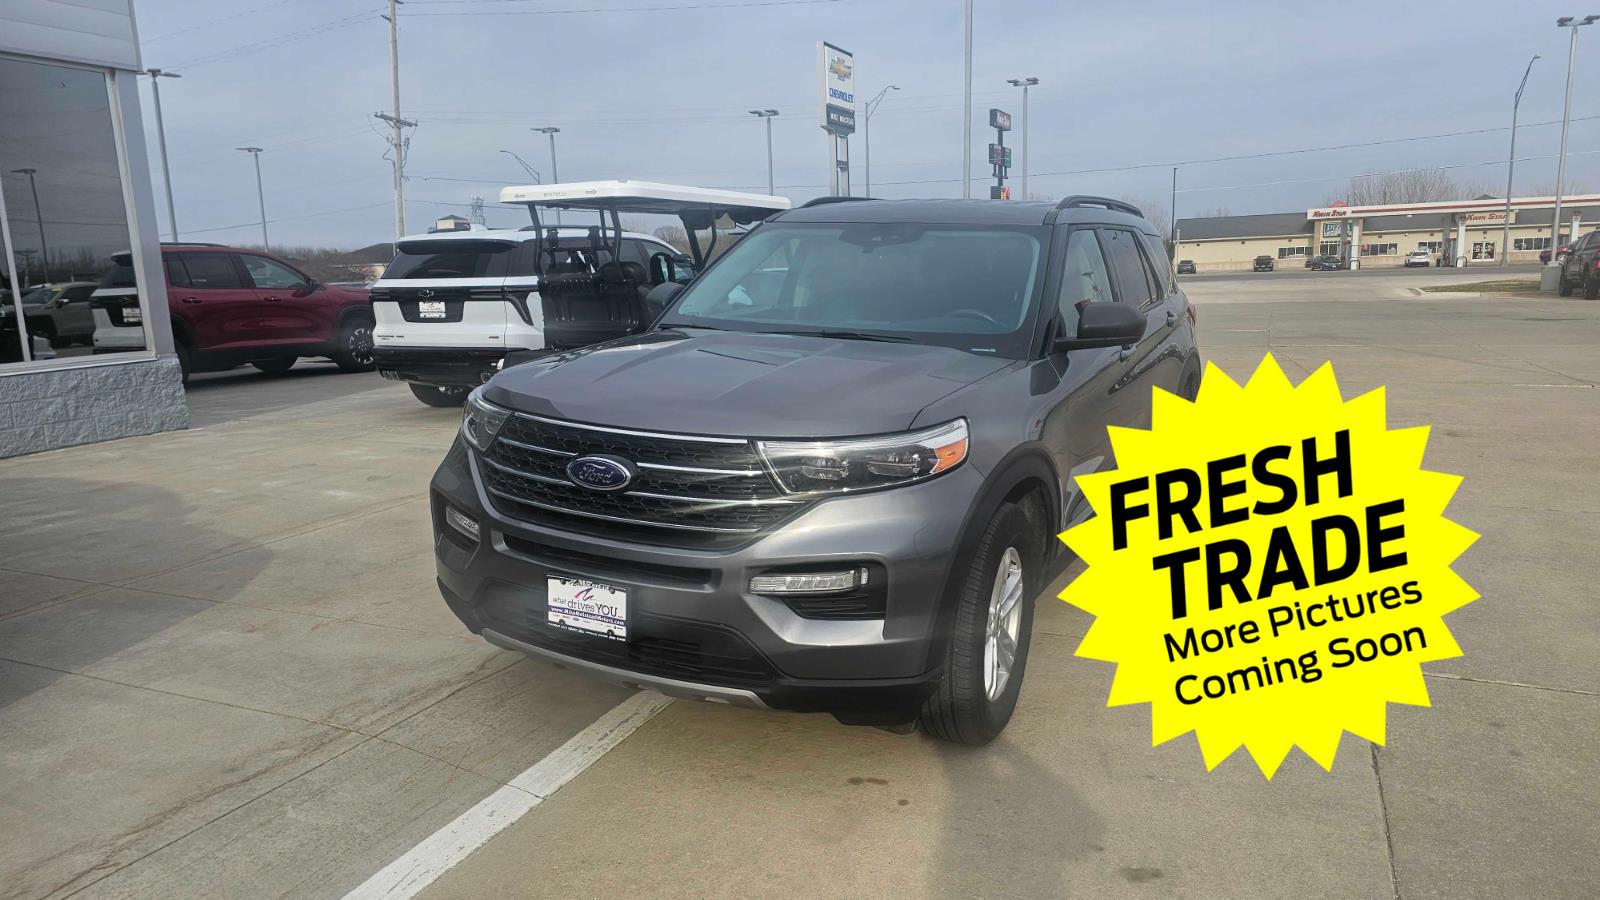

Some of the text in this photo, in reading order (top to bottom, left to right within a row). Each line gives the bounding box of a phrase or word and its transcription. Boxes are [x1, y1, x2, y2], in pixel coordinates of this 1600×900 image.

[829, 87, 854, 103] CHEVROLET
[579, 463, 614, 483] Ford
[567, 598, 596, 613] drives
[595, 603, 618, 618] YOU
